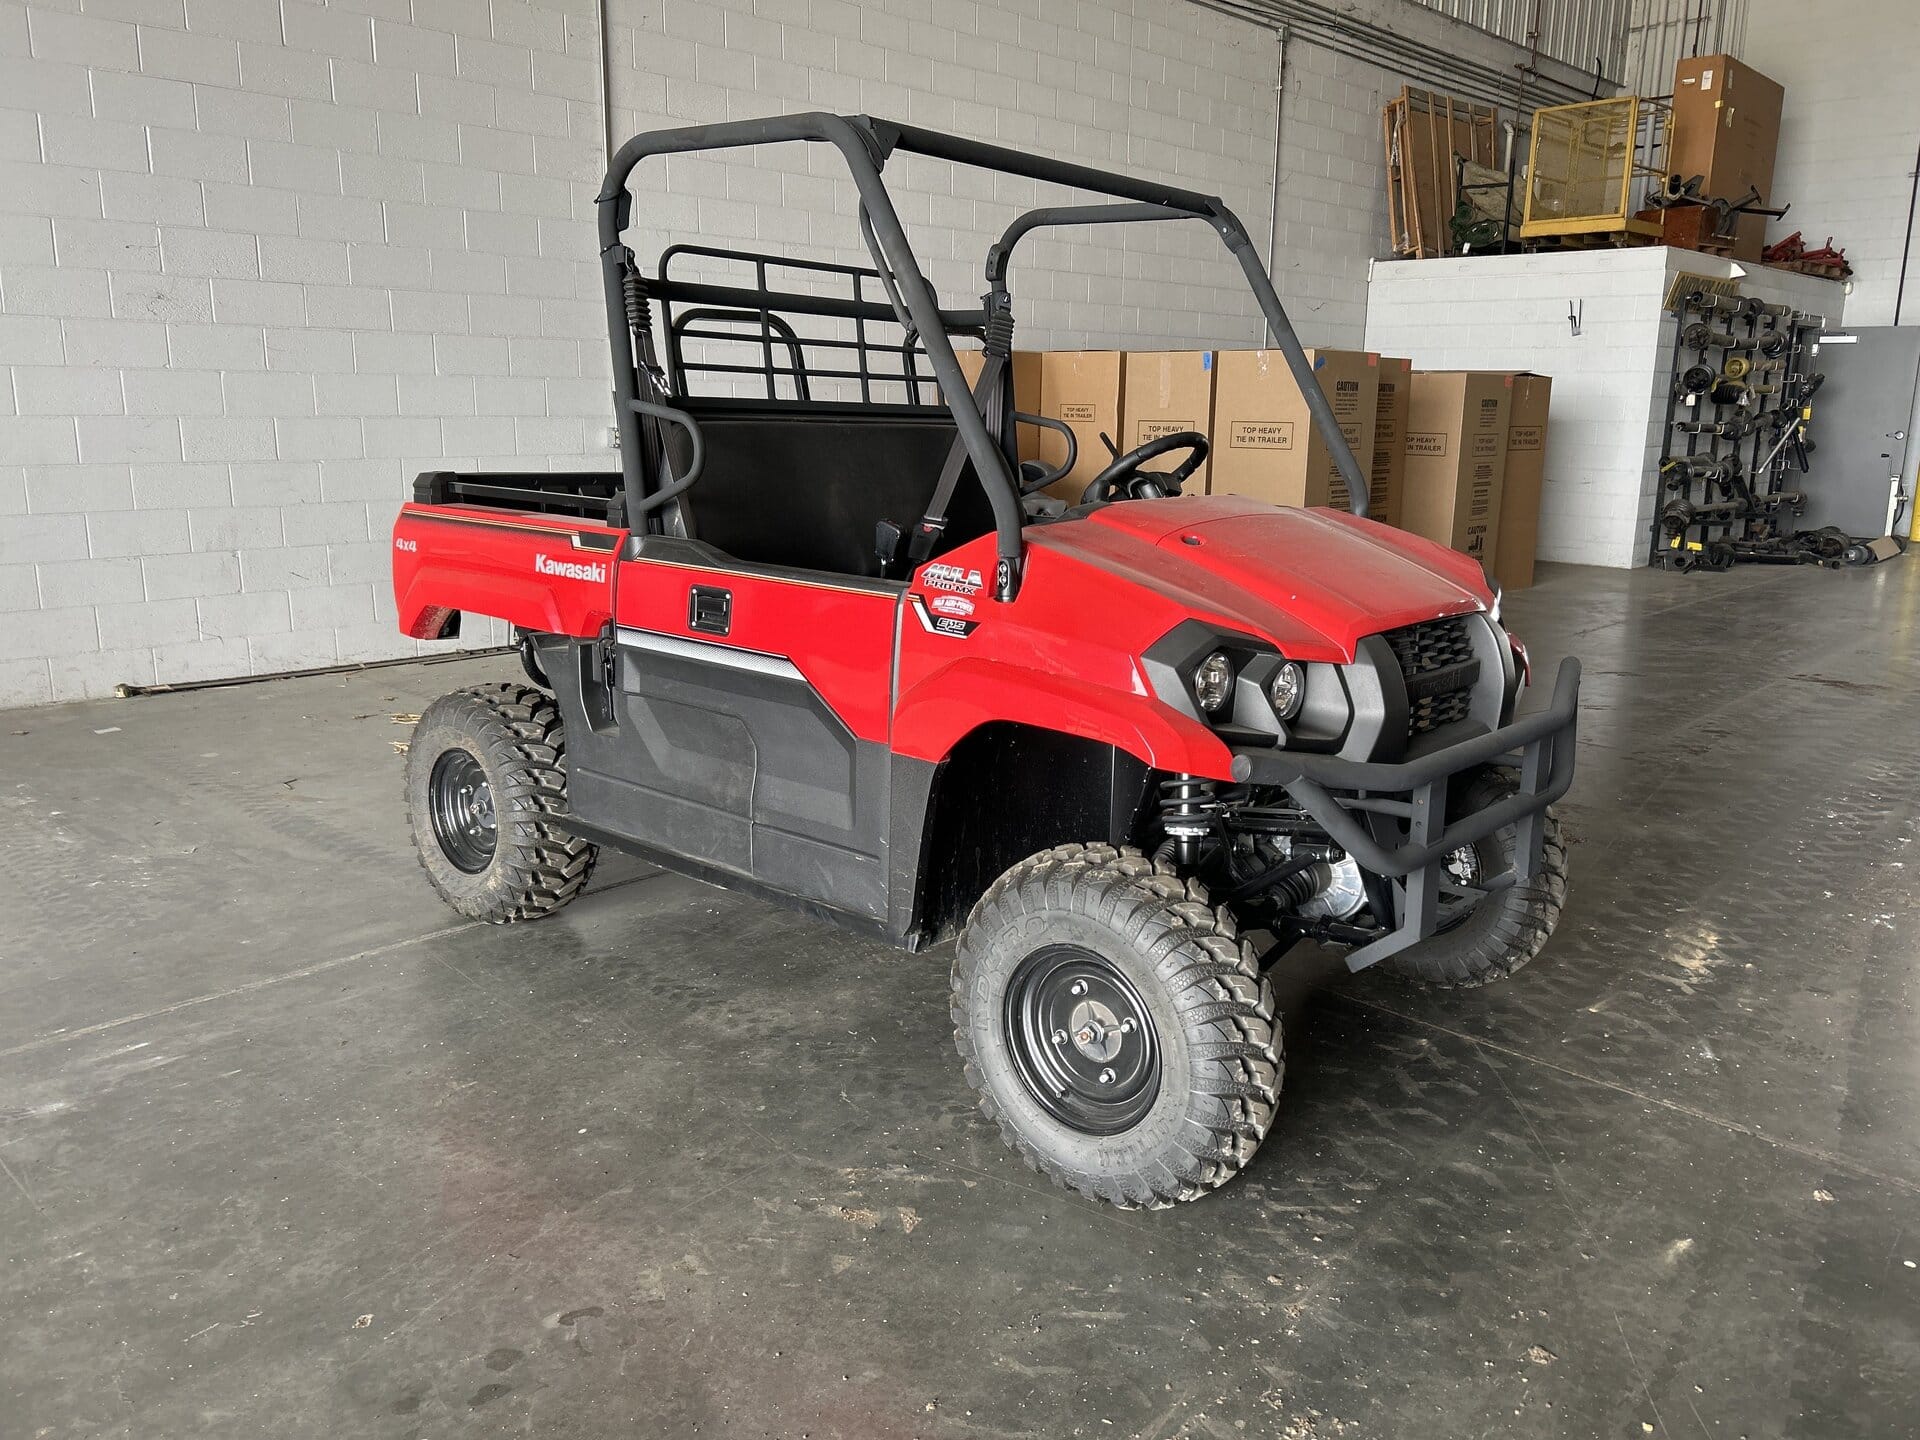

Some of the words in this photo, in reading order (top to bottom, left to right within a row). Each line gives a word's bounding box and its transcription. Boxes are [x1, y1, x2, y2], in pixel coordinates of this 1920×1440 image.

[1162, 425, 1184, 433] HEAVY
[1242, 426, 1257, 434] TOP
[1258, 427, 1282, 435] HEAVY
[1236, 435, 1247, 443] TIE
[395, 537, 417, 553] 4x4
[535, 553, 606, 583] Kawasaki
